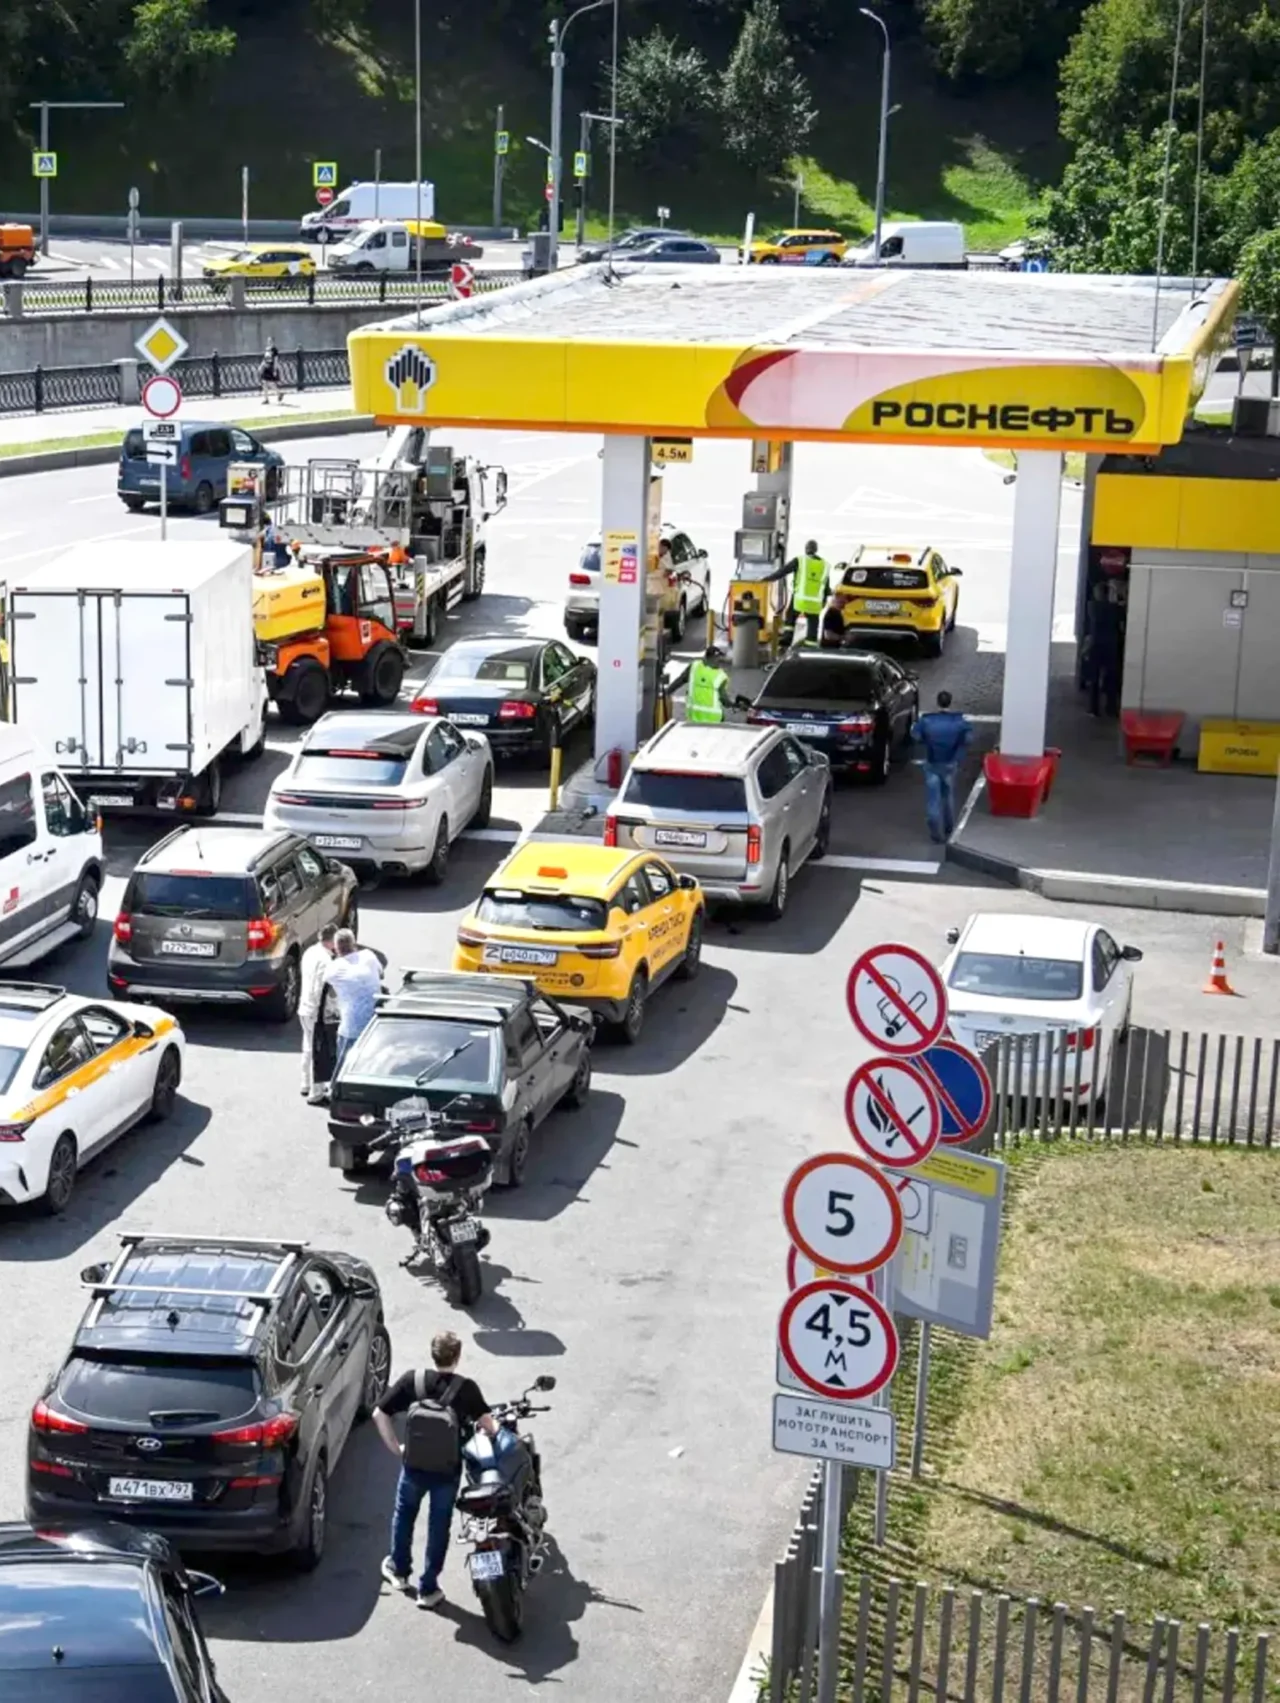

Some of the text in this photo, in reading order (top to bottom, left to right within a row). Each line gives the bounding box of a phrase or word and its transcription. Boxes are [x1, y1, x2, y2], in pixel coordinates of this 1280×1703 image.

[872, 401, 1135, 435] РОСНЕФТЬ
[825, 1190, 856, 1237] 5
[805, 1303, 872, 1348] 4,5
[824, 1349, 848, 1372] М
[795, 1406, 872, 1429] ЗАГЛУШИТЬ
[778, 1418, 889, 1446] МОТОТРАНСПОРТ
[811, 1438, 828, 1450] ЗА
